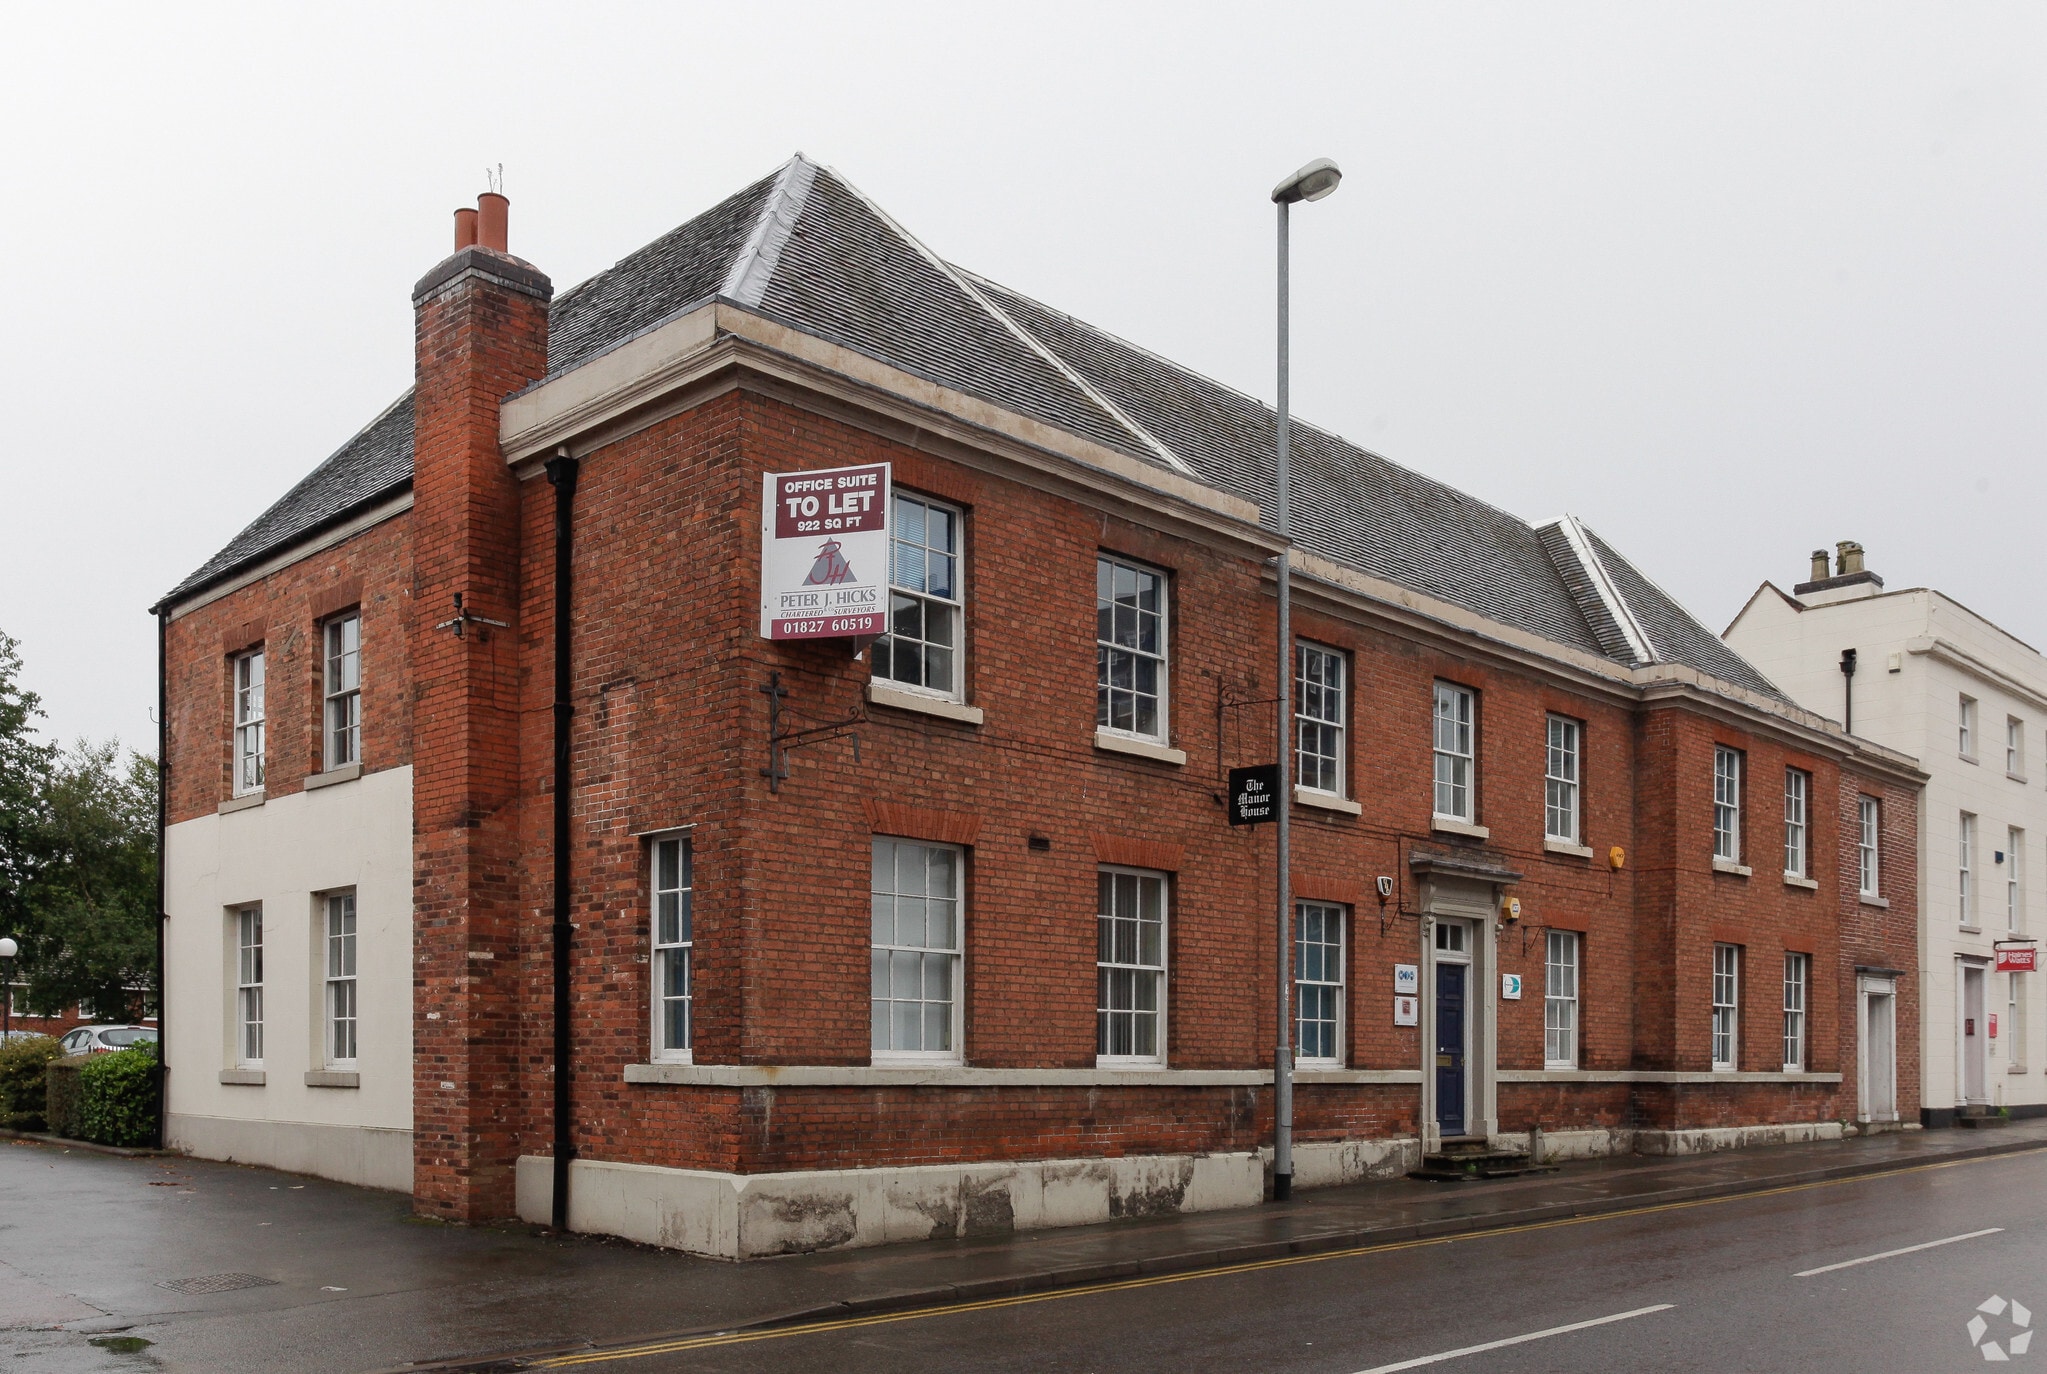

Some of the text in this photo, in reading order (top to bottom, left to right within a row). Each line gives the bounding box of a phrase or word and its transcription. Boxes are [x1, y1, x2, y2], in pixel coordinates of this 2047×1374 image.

[785, 474, 877, 493] OFFICE SUITE
[786, 490, 875, 518] TO LET
[797, 516, 862, 532] 922 SQ FT
[781, 589, 876, 608] PETER J. HICKS
[781, 606, 876, 618] CHARTERED SURVEYORS
[784, 617, 872, 634] 01827 60519
[1246, 779, 1264, 793] The
[1237, 792, 1271, 806] Manor
[1240, 805, 1270, 819] House
